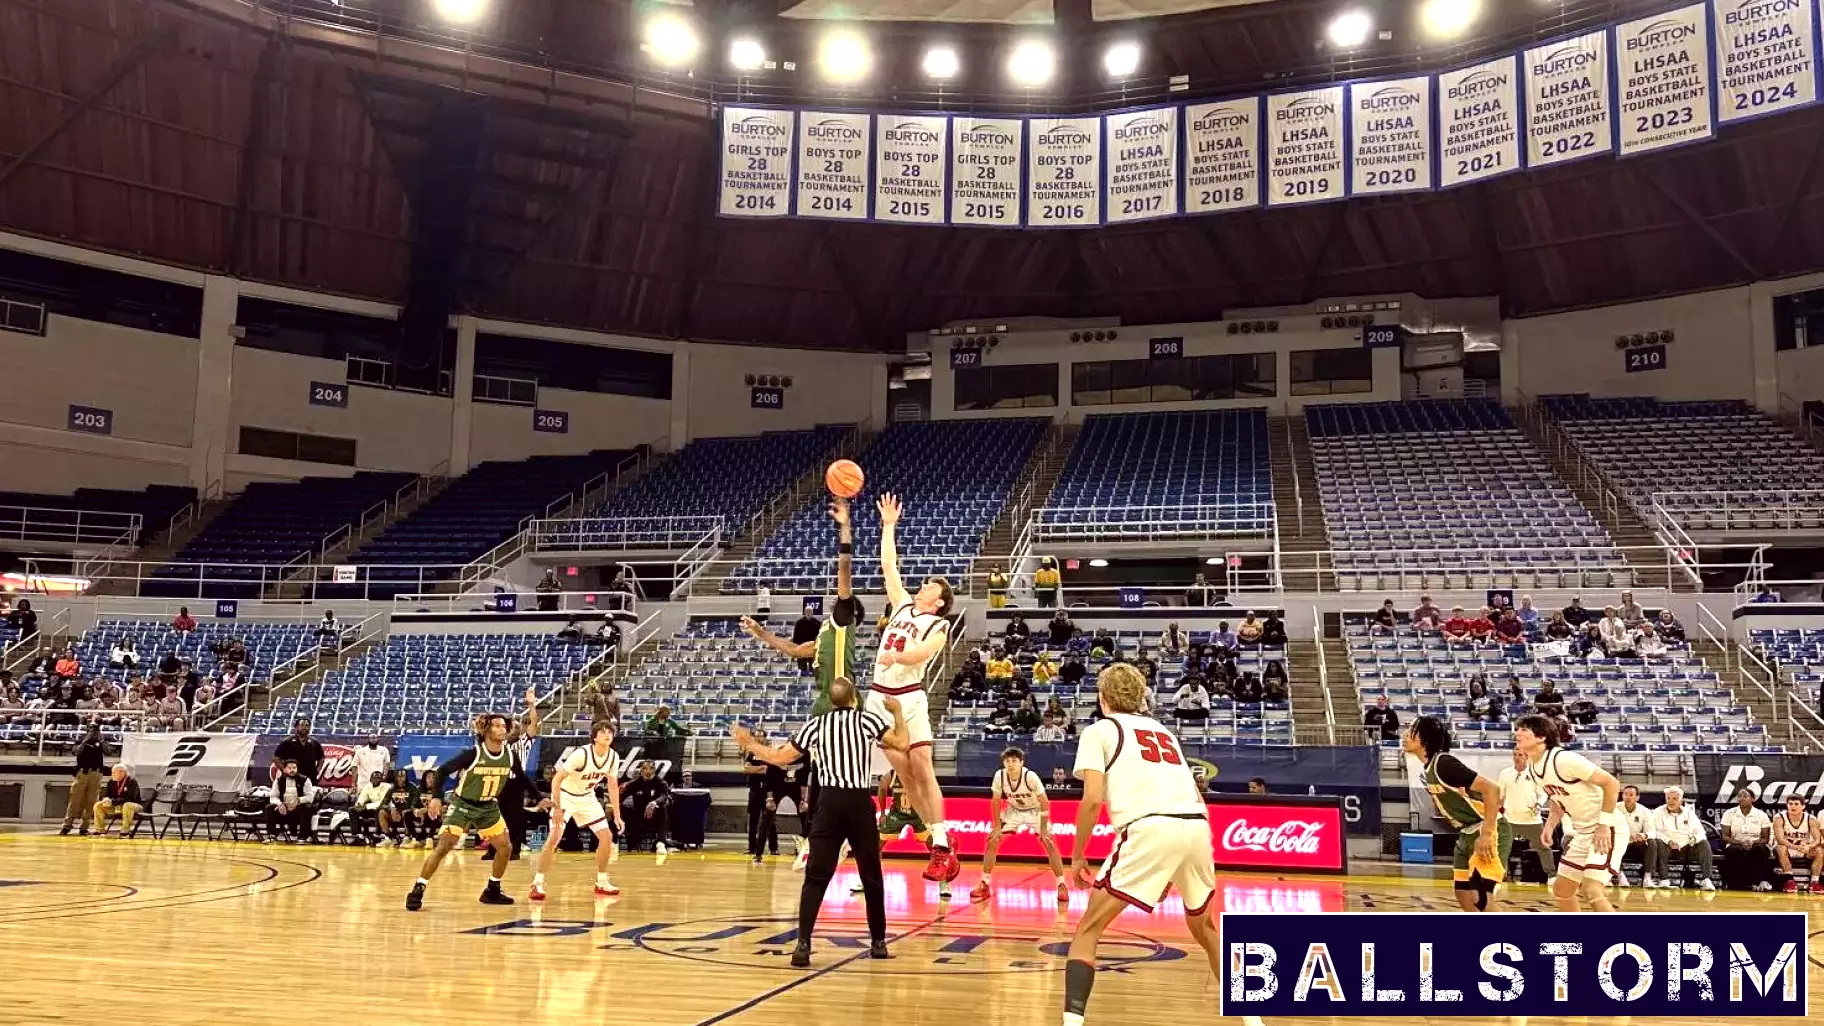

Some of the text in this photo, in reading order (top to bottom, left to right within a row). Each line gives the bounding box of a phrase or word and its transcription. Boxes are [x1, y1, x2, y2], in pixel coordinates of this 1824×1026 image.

[1726, 0, 1799, 25] BURTON
[1627, 24, 1696, 50] BURTON
[1734, 24, 1793, 48] LHSAA
[1728, 37, 1801, 63] BOYS STATE
[1534, 50, 1596, 76] BURTON
[1635, 50, 1690, 73] LHSAA
[1725, 51, 1805, 76] BASKETBALL
[1629, 64, 1698, 88] BOYS STATE
[1721, 61, 1811, 89] TOURNAMENT
[1448, 74, 1507, 98] BURTON
[1541, 77, 1591, 98] LHSAA
[1626, 76, 1701, 100] BASKETBALL
[1361, 93, 1420, 109] BURTON
[1536, 90, 1599, 112] BOYS STATE
[1622, 87, 1705, 113] TOURNAMENT
[1736, 82, 1798, 110] 2024
[1277, 104, 1334, 120] BURTON
[1455, 100, 1501, 120] LHSAA
[1534, 102, 1602, 124] BASKETBALL
[1194, 114, 1249, 130] BURTON
[1367, 116, 1413, 131] LHSAA
[1450, 112, 1508, 134] BOYS STATE
[1530, 112, 1607, 136] TOURNAMENT
[1636, 107, 1693, 132] 2023
[732, 124, 785, 135] BURTON
[808, 128, 861, 138] BURTON
[886, 131, 938, 141] BURTON
[1115, 123, 1168, 139] BURTON
[1283, 127, 1328, 142] LHSAA
[1447, 123, 1512, 145] BASKETBALL
[961, 133, 1013, 144] BURTON
[1039, 134, 1090, 144] BURTON
[1362, 130, 1419, 144] BOYS STATE
[1542, 132, 1595, 156] 2022
[1640, 130, 1687, 144] CONSECUTIVE
[729, 145, 787, 156] GIRLS TOP
[1199, 137, 1243, 152] LHSAA
[1278, 141, 1335, 155] BOYS STATE
[1359, 142, 1422, 155] BASKETBALL
[1444, 133, 1515, 157] TOURNAMENT
[807, 148, 861, 159] BOYS TOP
[884, 152, 938, 162] BOYS TOP
[1121, 145, 1163, 160] LHSAA
[1194, 150, 1250, 164] BOYS STATE
[1275, 151, 1336, 166] BASKETBALL
[1356, 152, 1426, 166] TOURNAMENT
[748, 158, 766, 170] 28
[824, 161, 843, 172] 28
[958, 155, 1015, 165] GIRLS TOP
[1038, 156, 1092, 165] BOYS TOP
[1116, 159, 1169, 172] BOYS STATE
[1458, 151, 1501, 175] 2021
[902, 165, 920, 176] 28
[977, 167, 995, 179] 28
[1055, 167, 1074, 179] 28
[1193, 161, 1252, 175] BASKETBALL
[1272, 161, 1341, 177] TOURNAMENT
[728, 171, 786, 180] BASKETBALL
[804, 173, 861, 183] BASKETBALL
[882, 177, 940, 187] BASKETBALL
[1113, 170, 1171, 183] BASKETBALL
[1189, 171, 1255, 186] TOURNAMENT
[1366, 168, 1416, 186] 2020
[724, 180, 787, 190] TOURNAMENT
[800, 182, 865, 193] TOURNAMENT
[880, 187, 942, 197] TOURNAMENT
[958, 181, 1014, 189] BASKETBALL
[1036, 182, 1093, 190] BASKETBALL
[1111, 179, 1173, 195] TOURNAMENT
[1284, 178, 1328, 197] 2019
[955, 190, 1016, 199] TOURNAMENT
[1033, 191, 1095, 200] TOURNAMENT
[1201, 187, 1244, 205] 2018
[736, 195, 776, 209] 2014
[812, 197, 852, 211] 2014
[890, 201, 930, 216] 2015
[1123, 196, 1162, 213] 2017
[965, 204, 1004, 218] 2015
[1043, 205, 1083, 218] 2016
[1368, 331, 1394, 343] 209
[1153, 343, 1178, 354] 208
[954, 353, 977, 364] 207
[1631, 352, 1660, 366] 210
[315, 388, 342, 401] 204
[756, 393, 778, 404] 206
[74, 412, 105, 427] 203
[538, 415, 563, 428] 205
[1124, 594, 1140, 602] 108
[884, 633, 907, 652] 54
[1134, 729, 1182, 766] 55
[482, 775, 501, 797] 11
[1222, 818, 1326, 854] Coca-Cola
